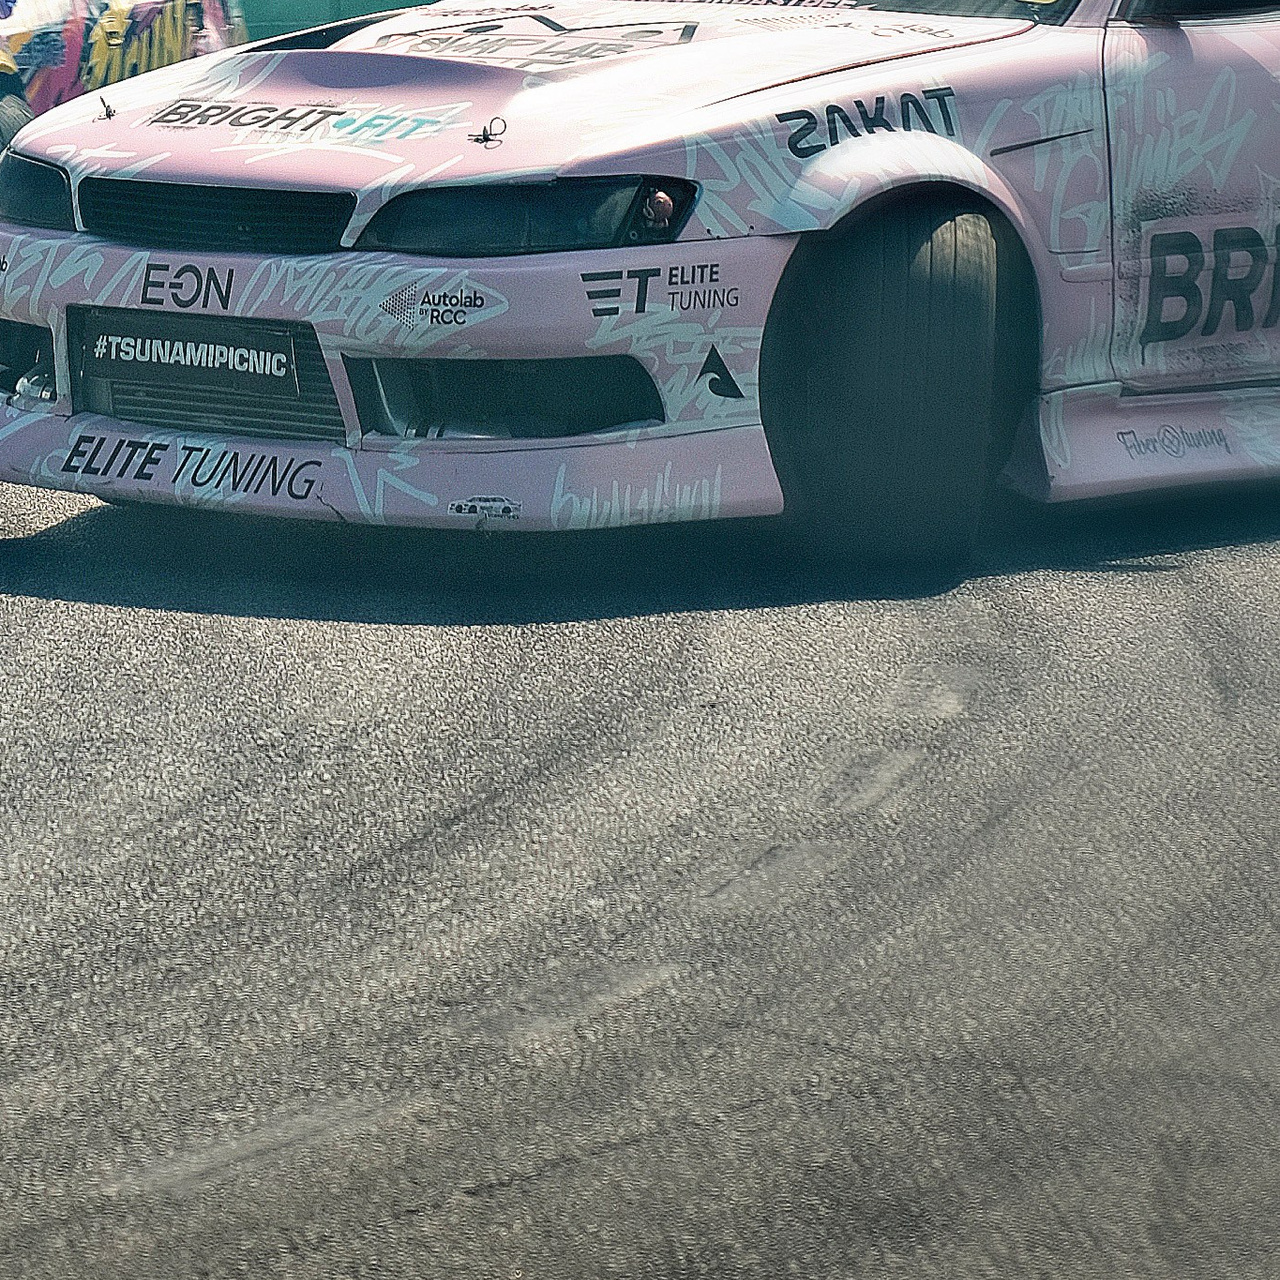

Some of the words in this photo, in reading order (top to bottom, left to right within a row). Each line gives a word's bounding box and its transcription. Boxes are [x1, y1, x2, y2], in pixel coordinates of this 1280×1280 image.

[154, 102, 347, 131] BRIGHT
[667, 263, 720, 286] ELITE
[420, 289, 485, 308] Autolab
[667, 287, 740, 312] TUNING
[418, 308, 429, 316] BY
[429, 308, 467, 325] RCC
[93, 334, 288, 378] #TSUNAMIPICNIC
[61, 434, 170, 481] ELITE
[169, 444, 323, 502] TUNING
